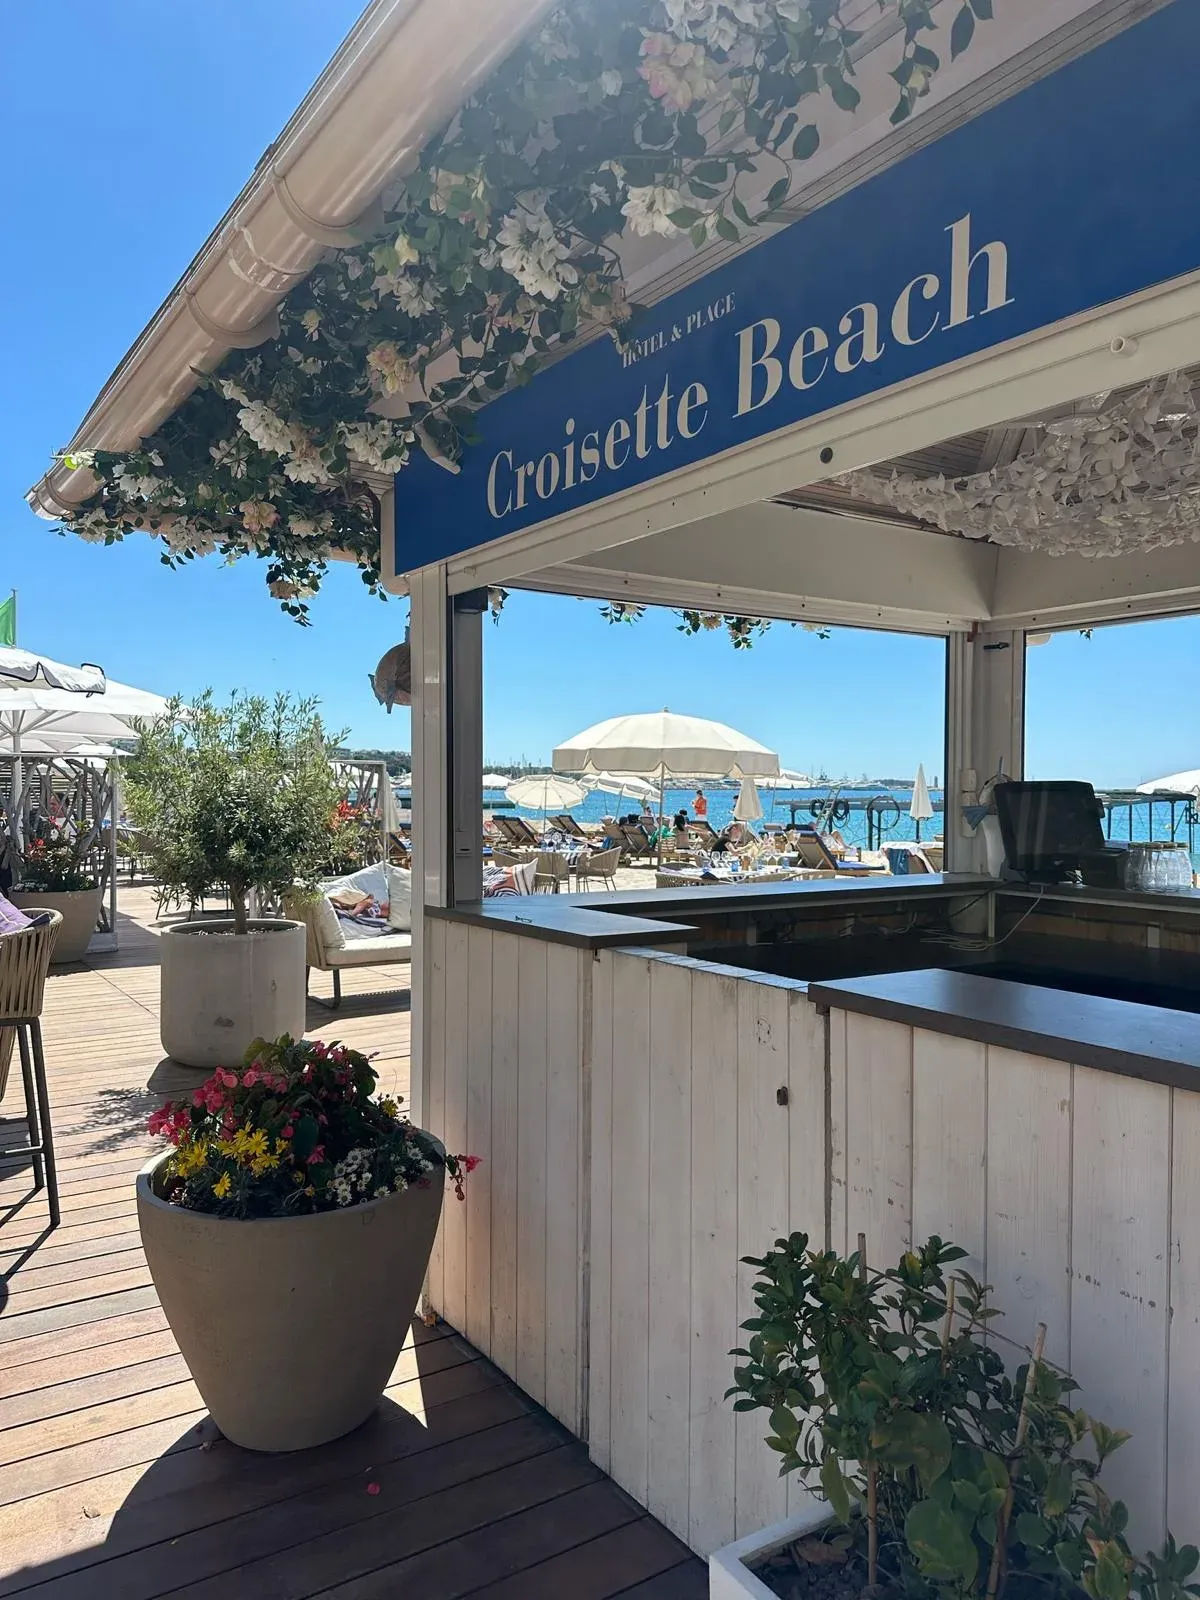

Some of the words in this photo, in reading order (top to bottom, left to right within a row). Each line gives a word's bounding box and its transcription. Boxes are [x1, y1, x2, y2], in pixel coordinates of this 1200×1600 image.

[486, 373, 709, 519] Croisette
[732, 212, 1015, 418] Beach
[671, 324, 683, 342] &
[687, 292, 736, 334] PLAGE
